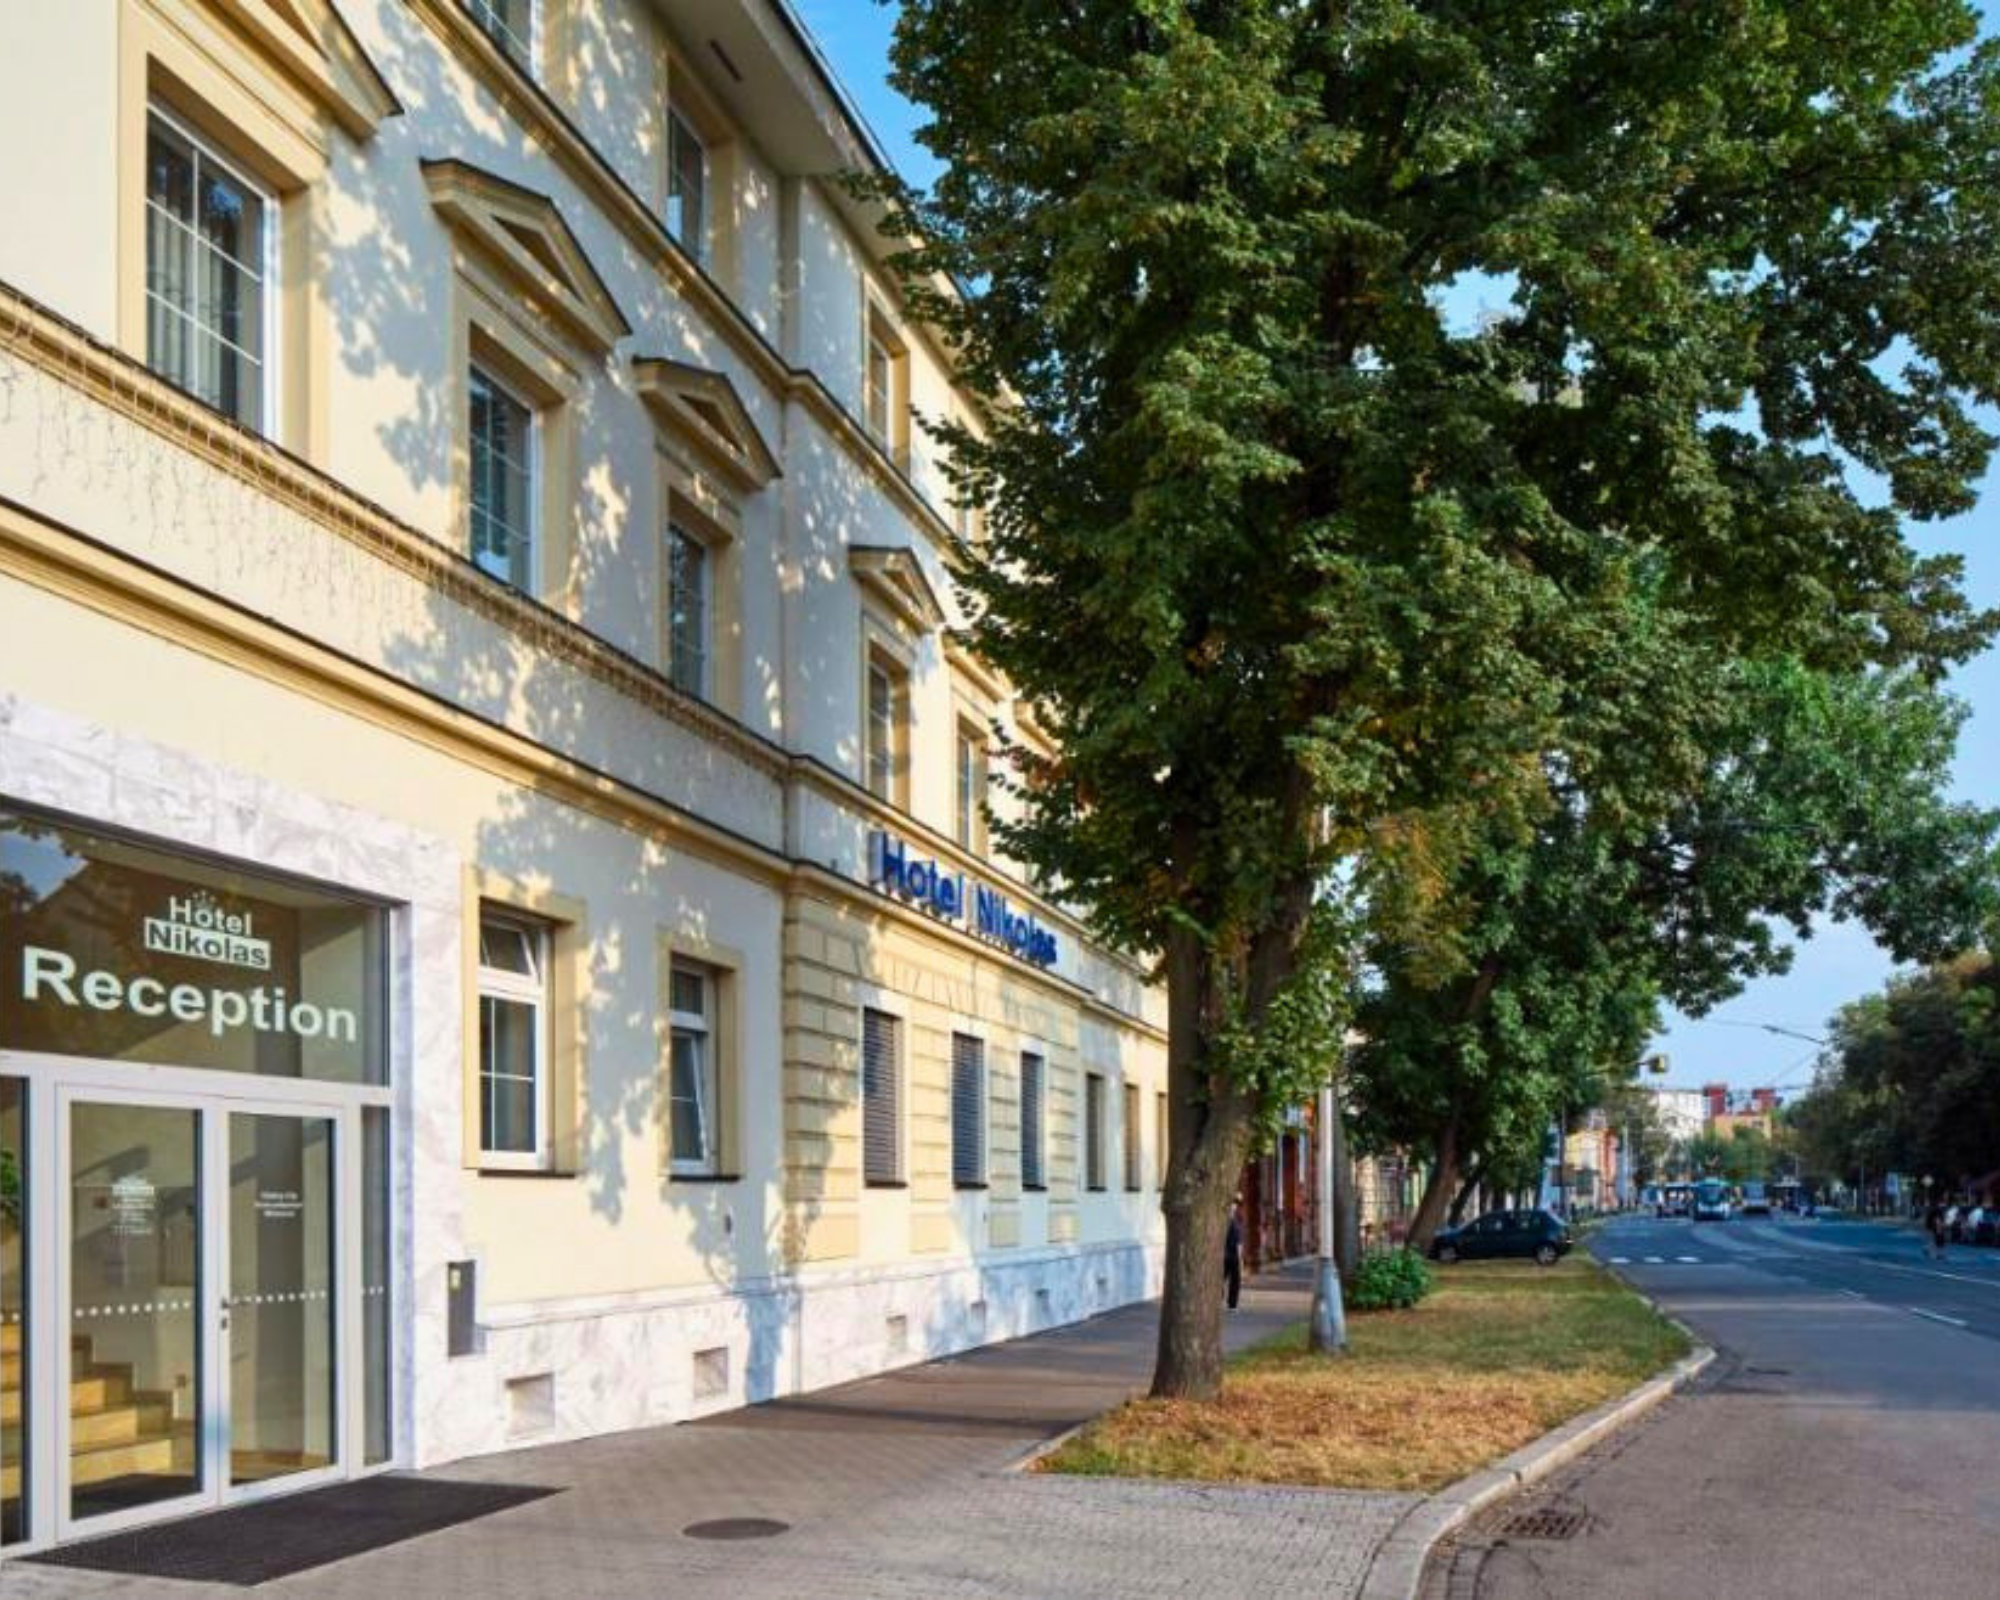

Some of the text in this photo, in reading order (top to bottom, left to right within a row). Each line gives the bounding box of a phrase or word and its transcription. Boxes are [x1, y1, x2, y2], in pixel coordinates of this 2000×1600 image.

[169, 895, 252, 936] Hotel
[870, 830, 1058, 965] Hotel Nikolas
[148, 920, 268, 968] Nikolas
[23, 945, 357, 1042] Reception
